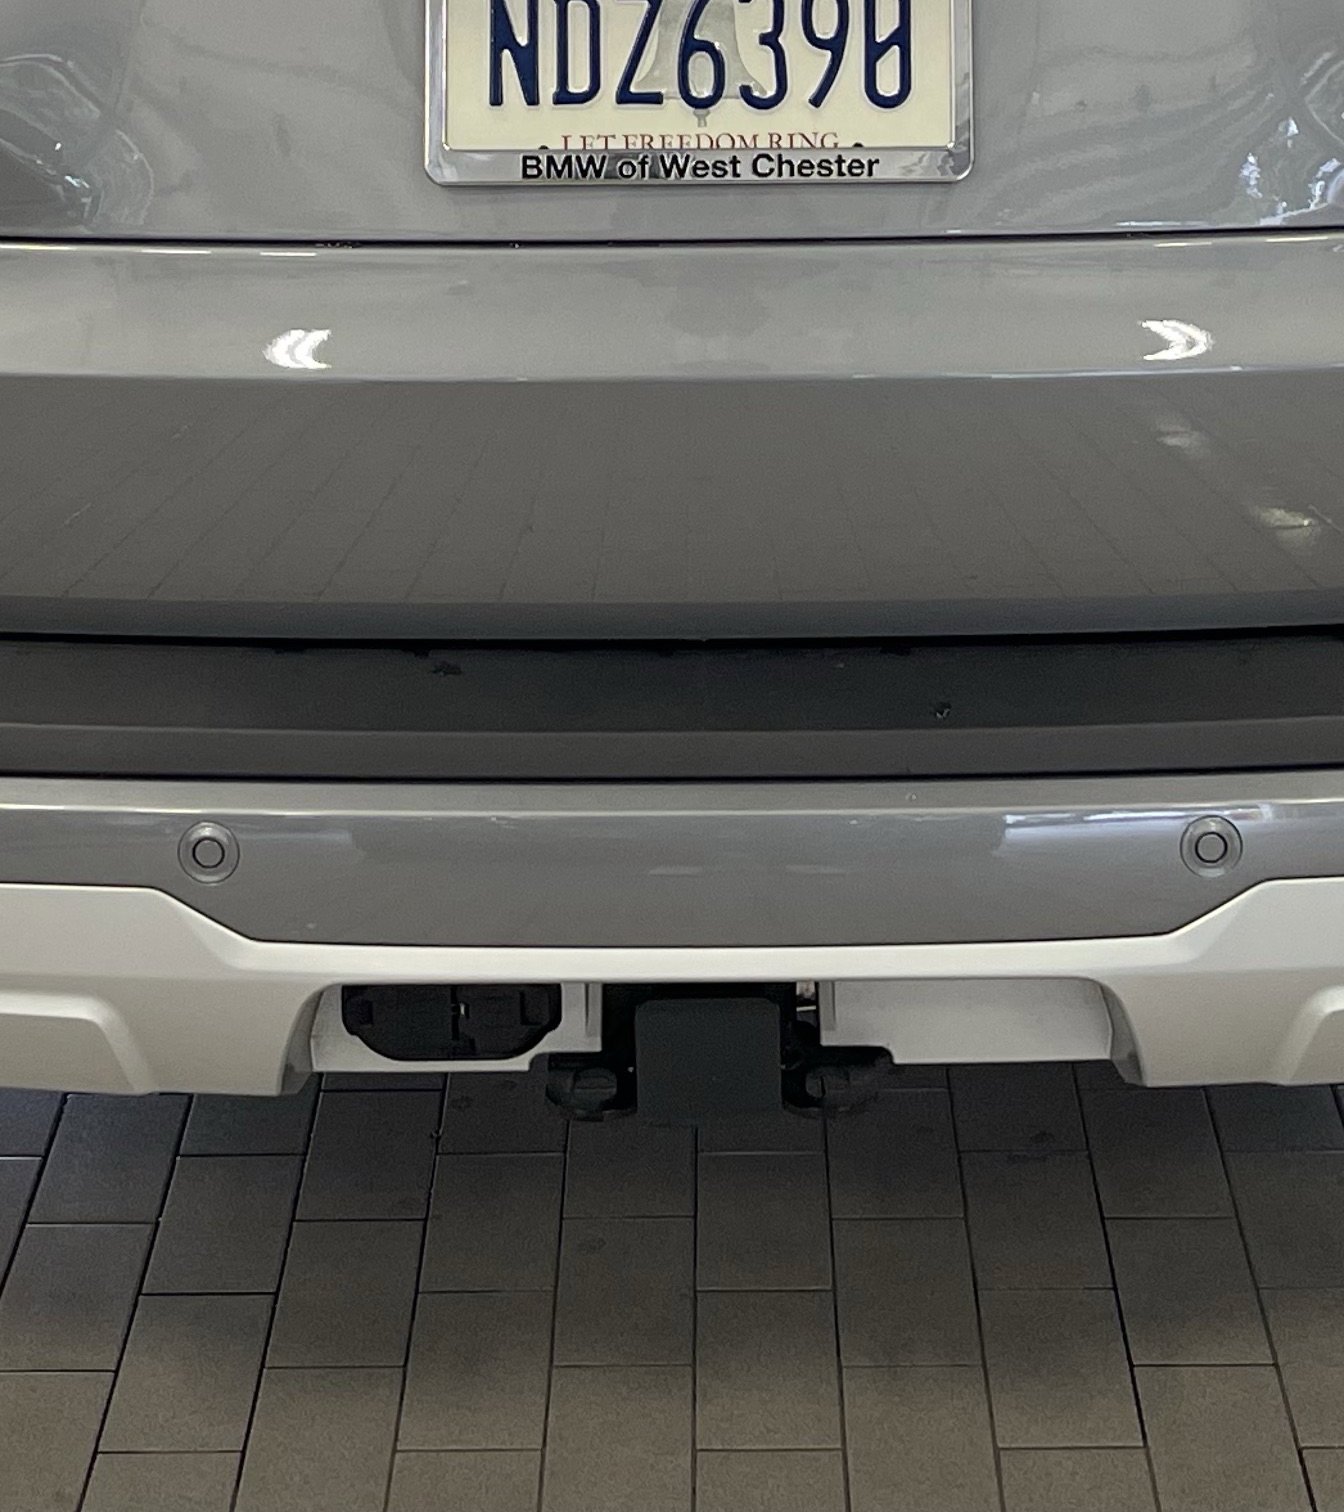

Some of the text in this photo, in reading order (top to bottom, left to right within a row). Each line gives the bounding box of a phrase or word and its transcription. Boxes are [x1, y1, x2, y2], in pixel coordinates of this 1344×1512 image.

[622, 133, 759, 150] FREEDOM
[767, 132, 839, 149] RING
[522, 153, 880, 179] BMW of West Chester
